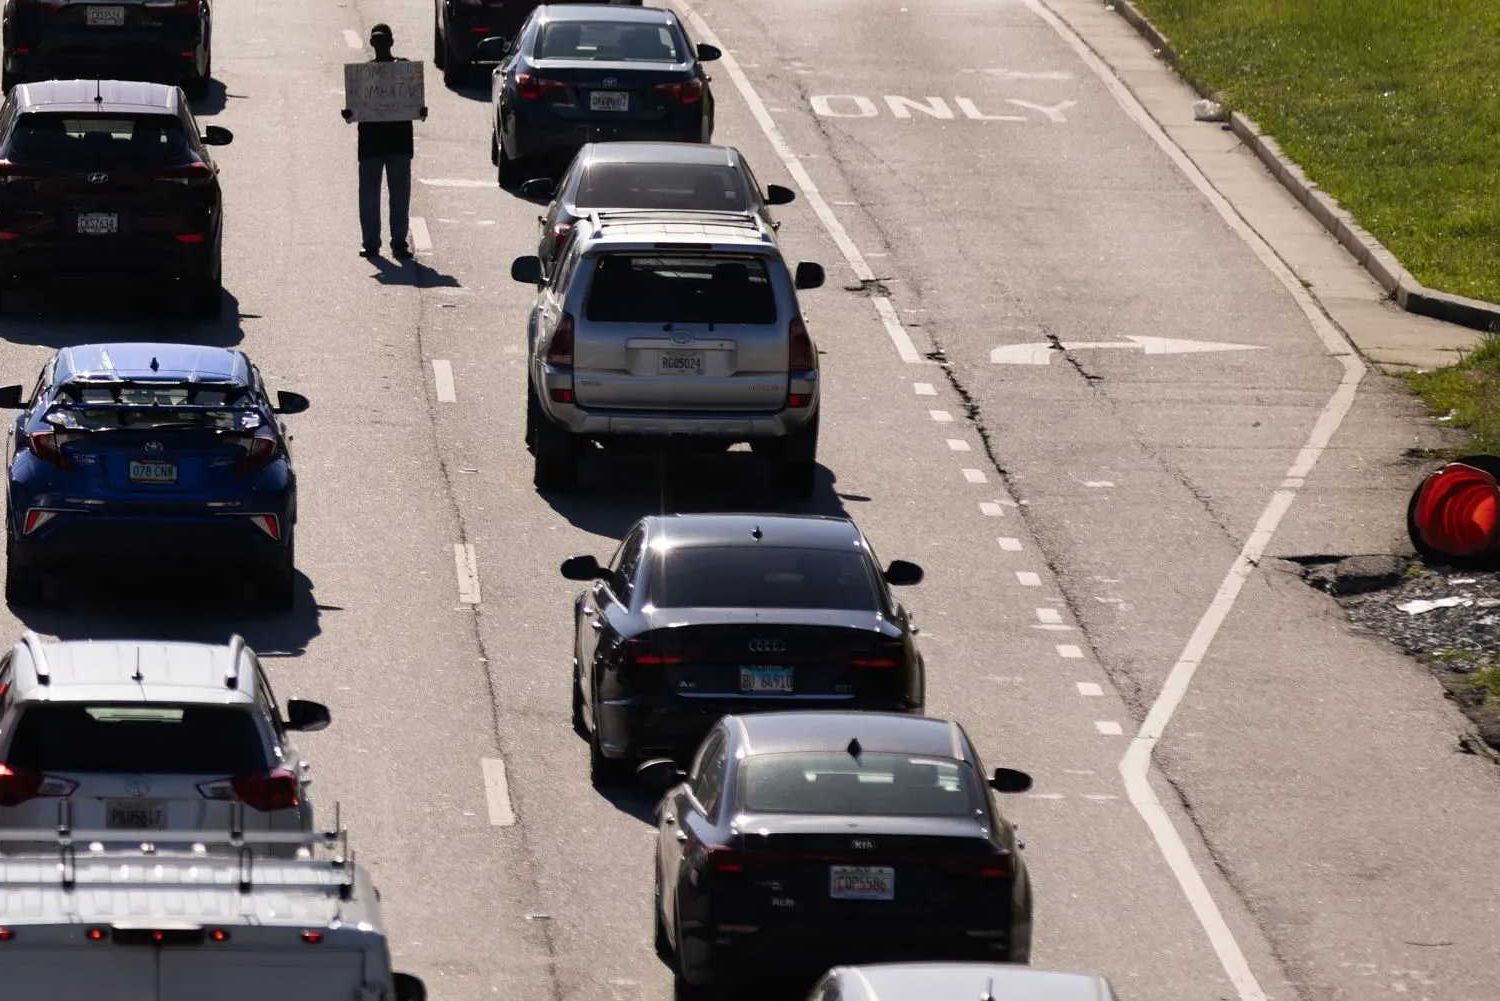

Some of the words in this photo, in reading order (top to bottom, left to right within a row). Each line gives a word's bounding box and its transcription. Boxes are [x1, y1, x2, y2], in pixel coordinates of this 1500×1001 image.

[809, 94, 1078, 122] ONLY
[854, 841, 874, 850] KIA
[771, 898, 795, 908] ALM
